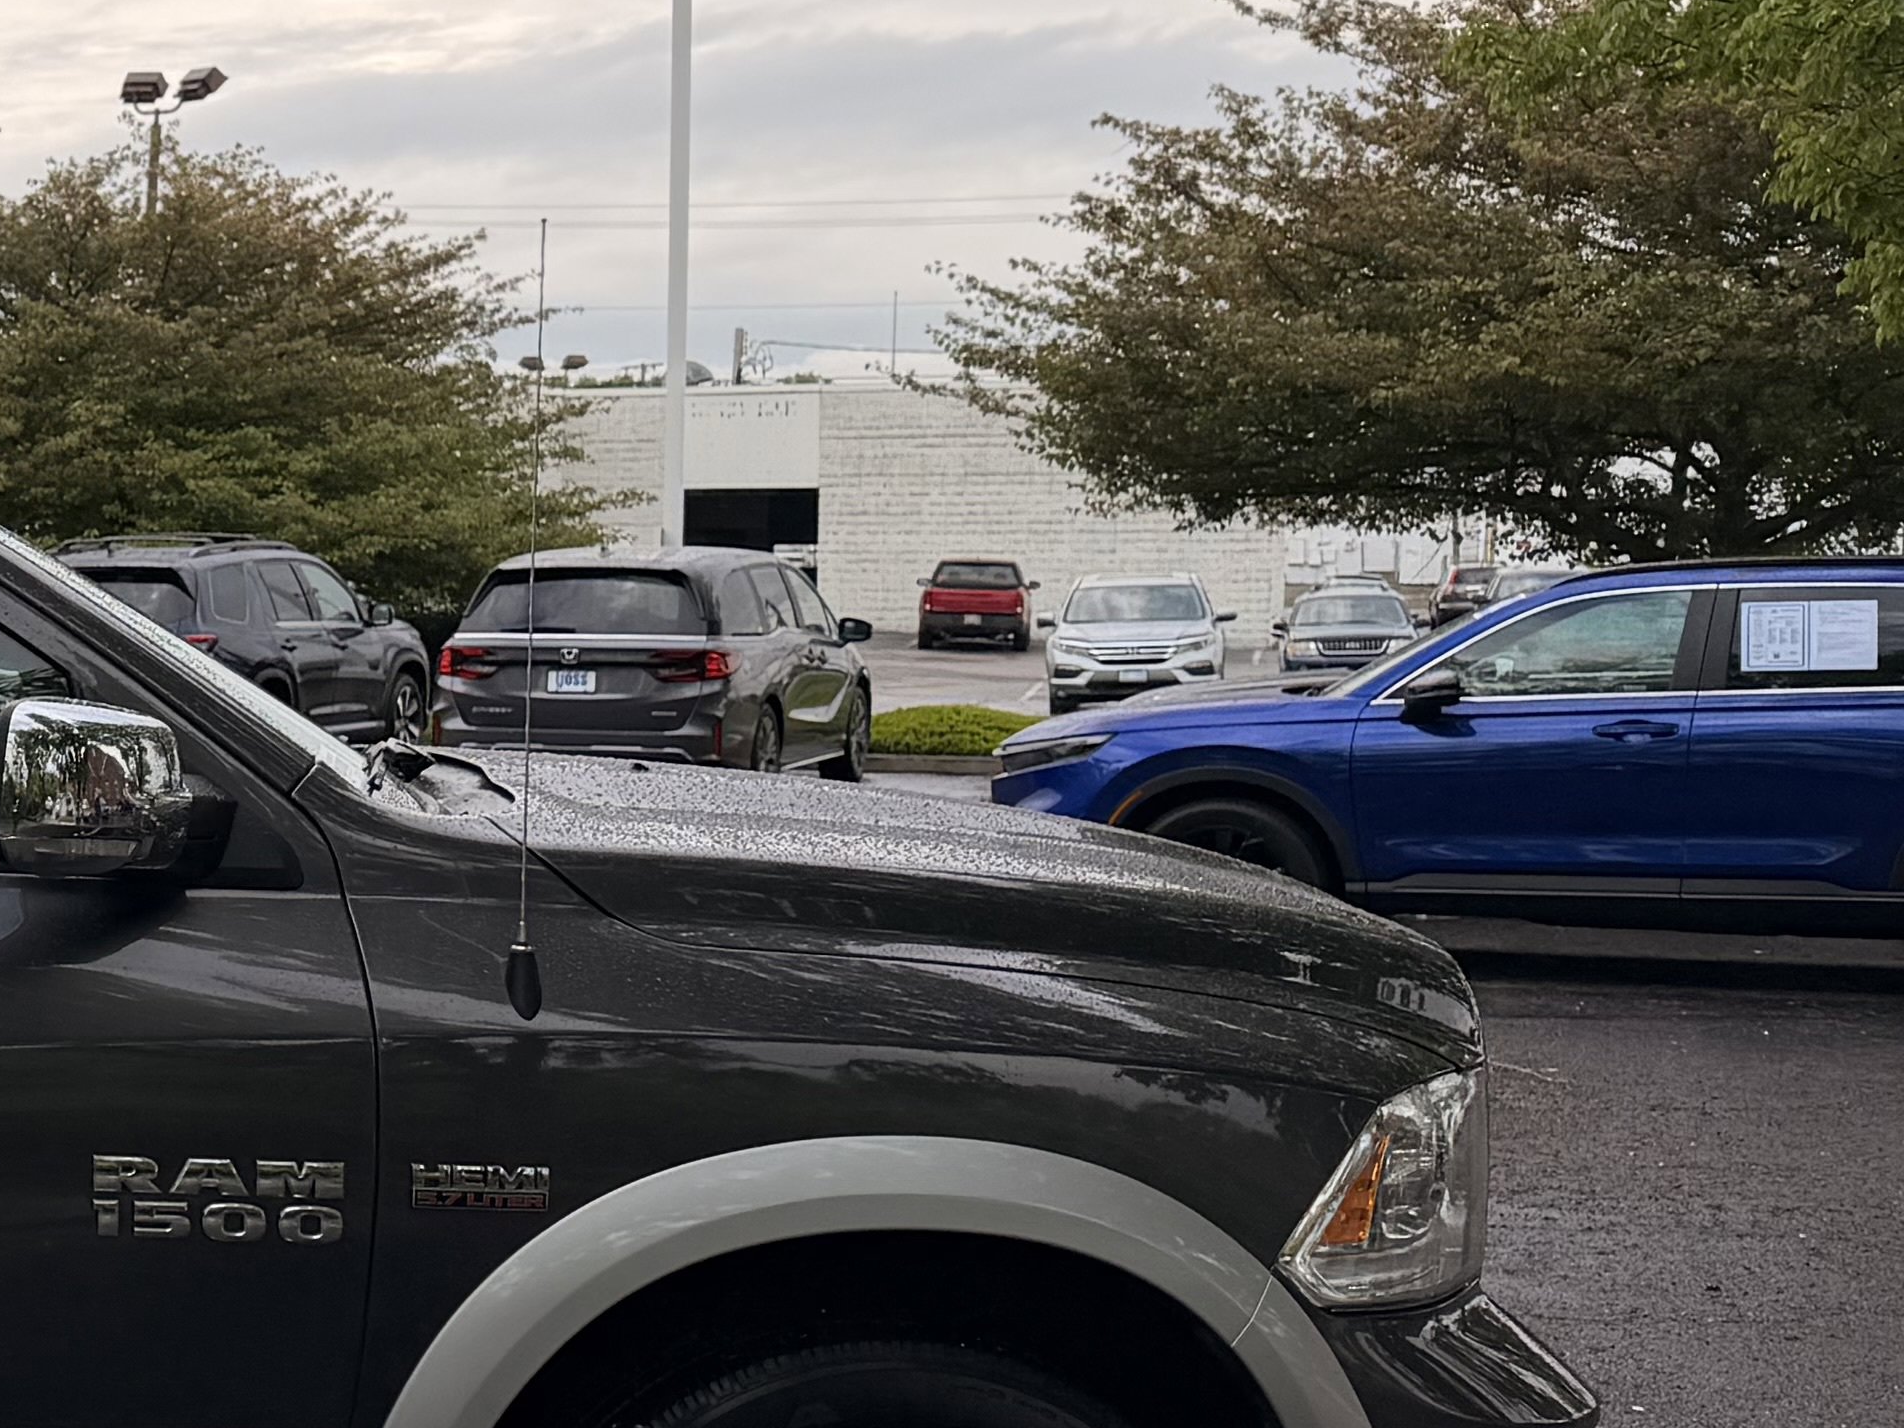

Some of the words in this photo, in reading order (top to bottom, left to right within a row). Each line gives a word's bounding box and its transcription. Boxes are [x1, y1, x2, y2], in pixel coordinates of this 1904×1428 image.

[92, 1155, 345, 1199] RAM
[411, 1163, 550, 1190] HEMI
[416, 1190, 463, 1206] 5.7
[466, 1192, 545, 1208] LITER
[92, 1199, 344, 1244] 1500
